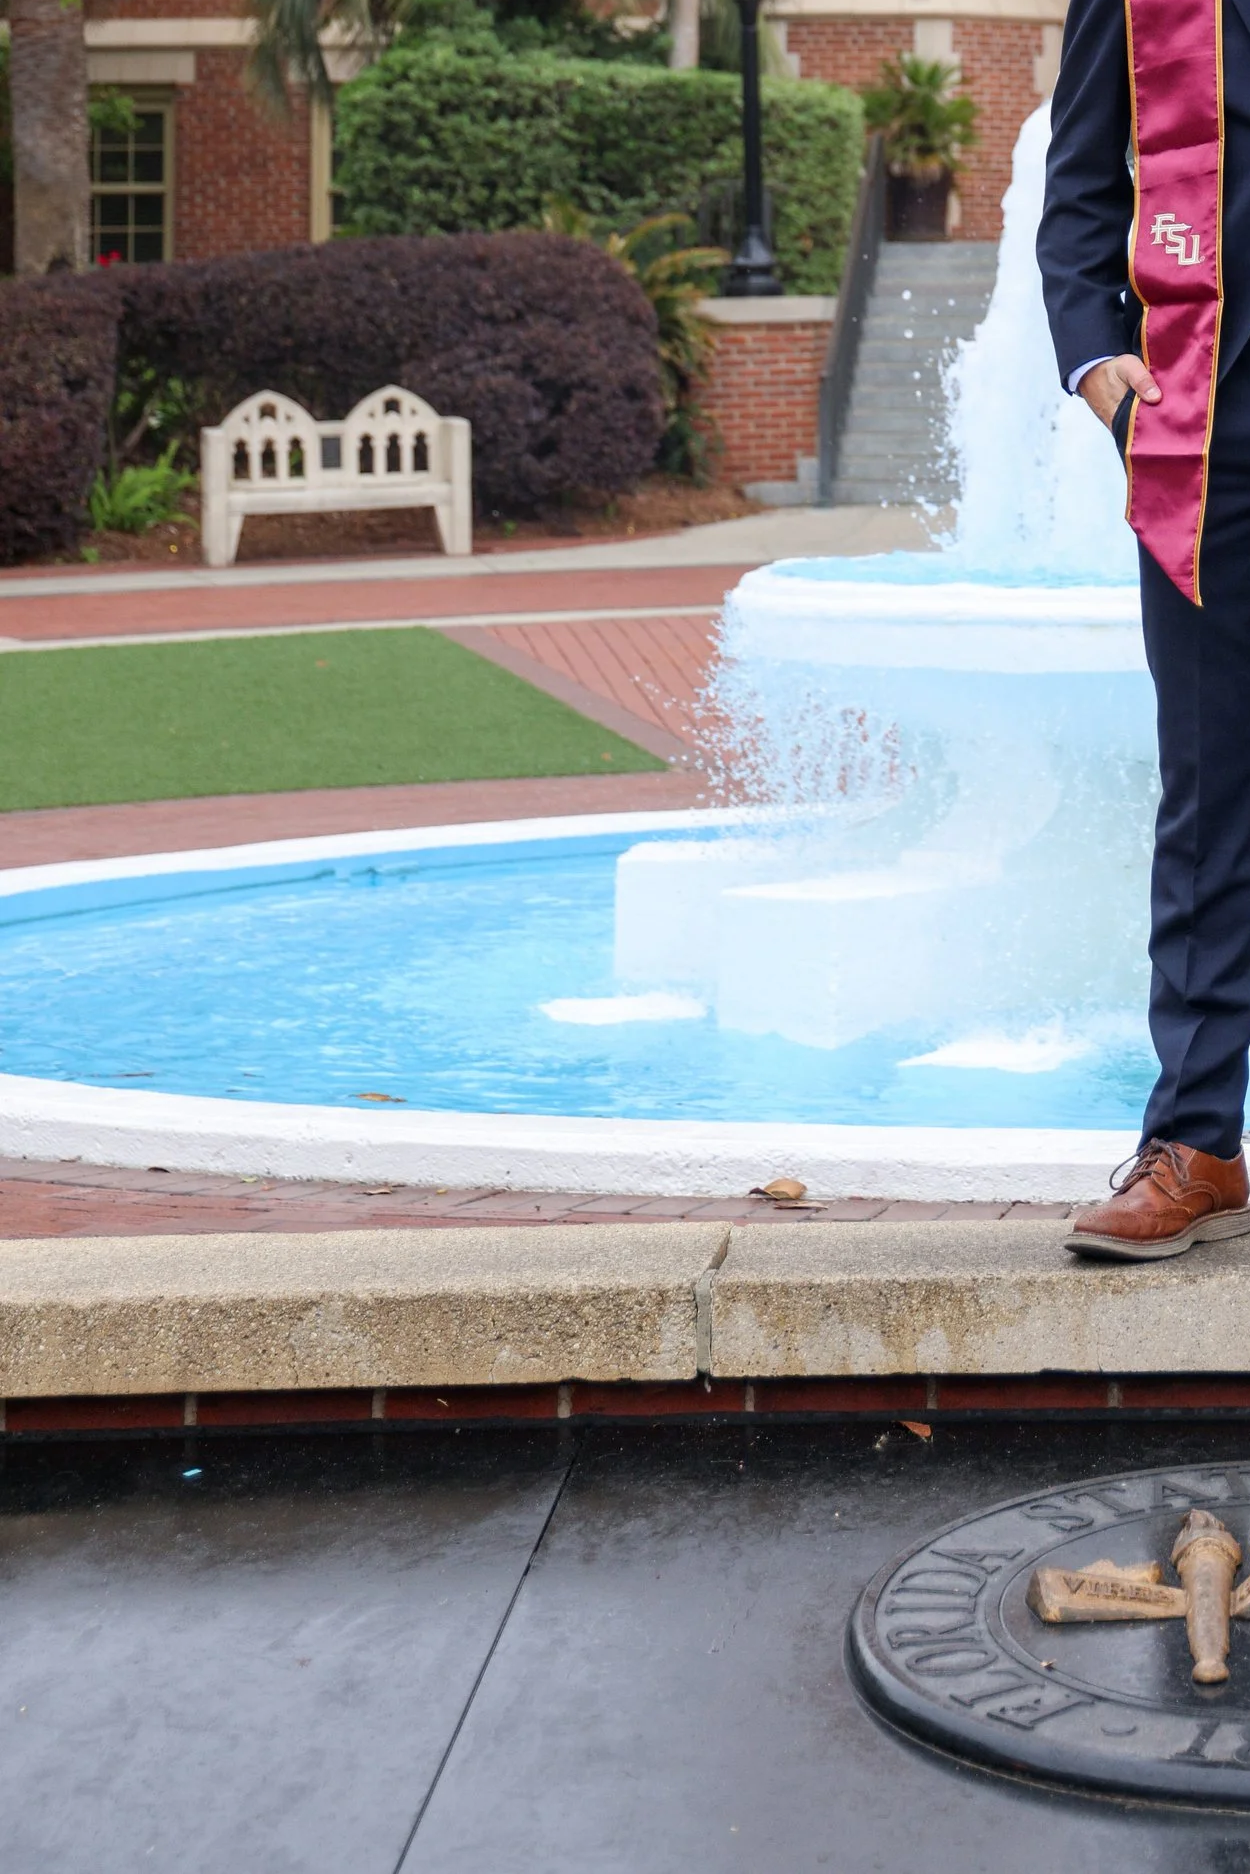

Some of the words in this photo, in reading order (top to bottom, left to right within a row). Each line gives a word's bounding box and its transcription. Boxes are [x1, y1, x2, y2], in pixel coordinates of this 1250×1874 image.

[1150, 213, 1201, 265] FSU
[1062, 1575, 1176, 1604] VIRES
[886, 1547, 1095, 1730] FLORIDA
